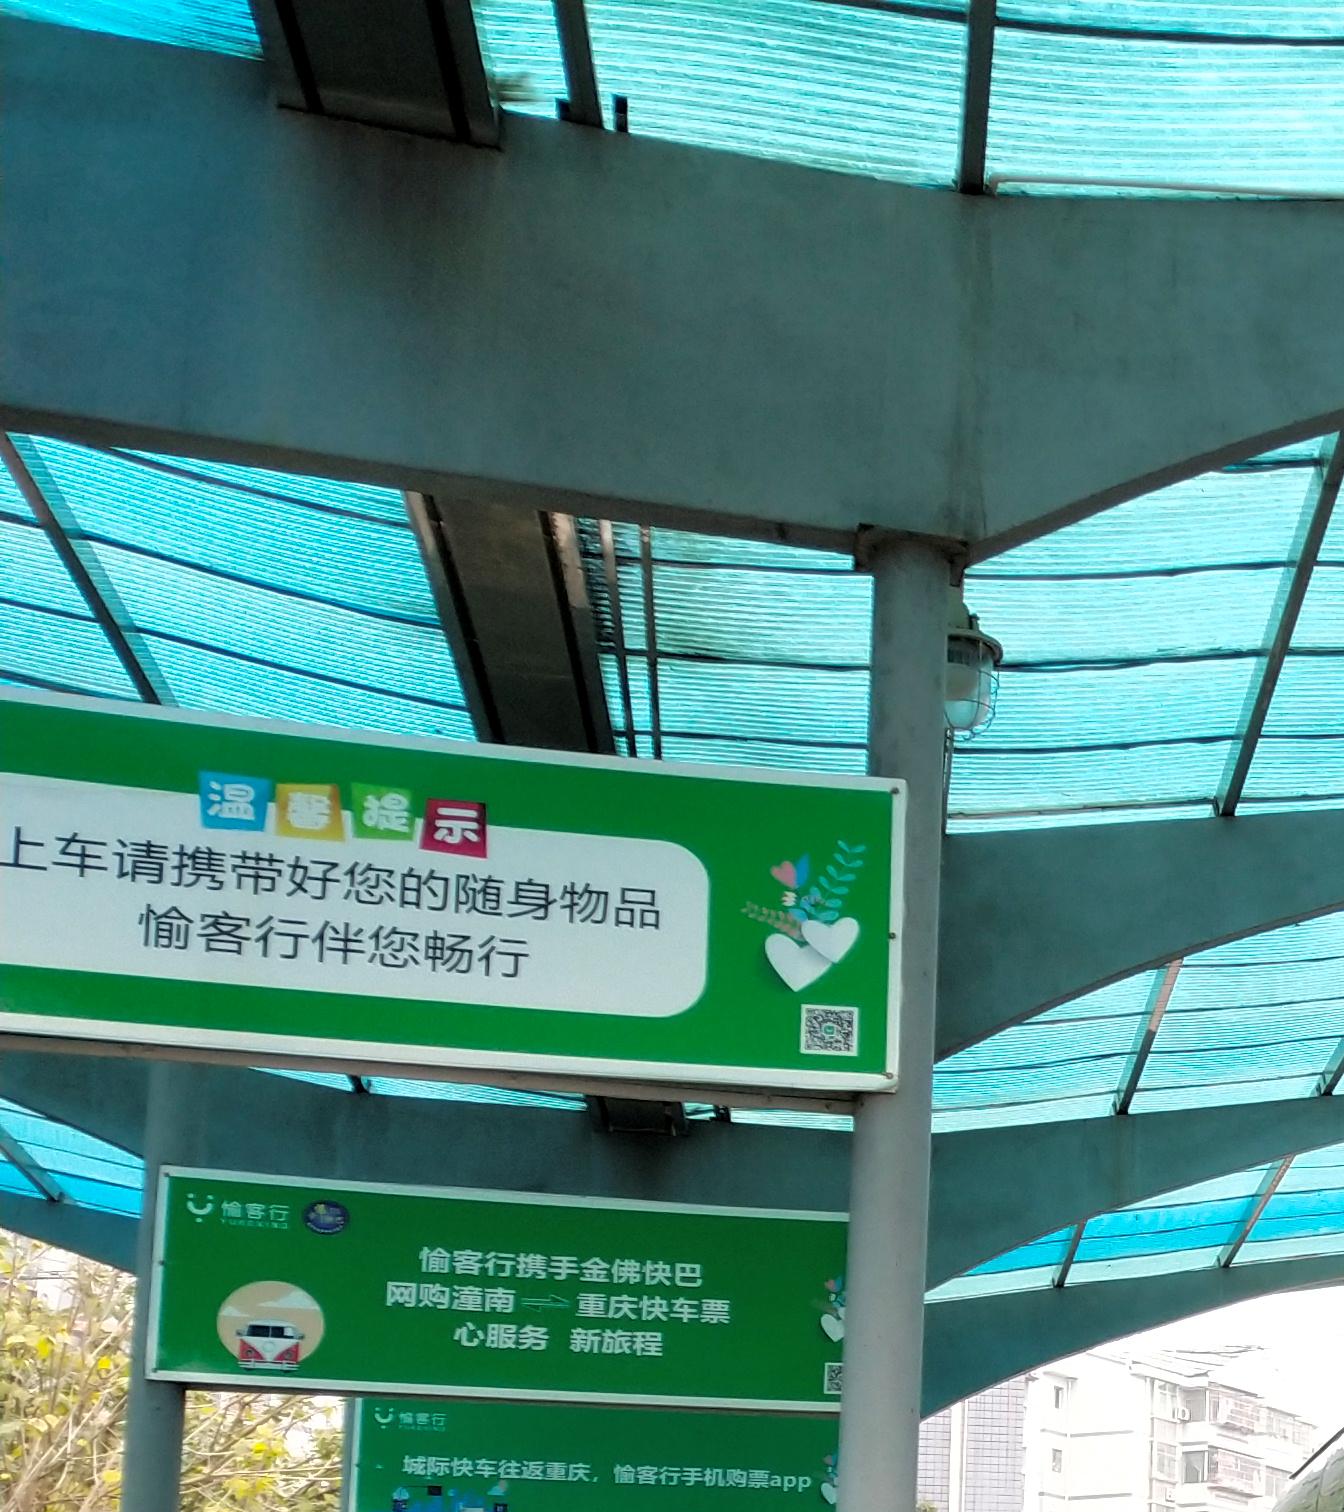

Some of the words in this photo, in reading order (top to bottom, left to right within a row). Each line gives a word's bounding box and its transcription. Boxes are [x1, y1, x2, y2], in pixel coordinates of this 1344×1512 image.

[206, 779, 482, 846] 温馨提示
[0, 824, 662, 931] 上车请携带好您的随身物品
[137, 902, 531, 979] 愉客行伴您畅行
[418, 1246, 704, 1288] 愉客行携手金佛快巴
[386, 1281, 517, 1314] 网购潼南
[575, 1291, 731, 1325] 重庆快车票
[453, 1322, 550, 1352] 心服务
[569, 1326, 664, 1357] 新旅程
